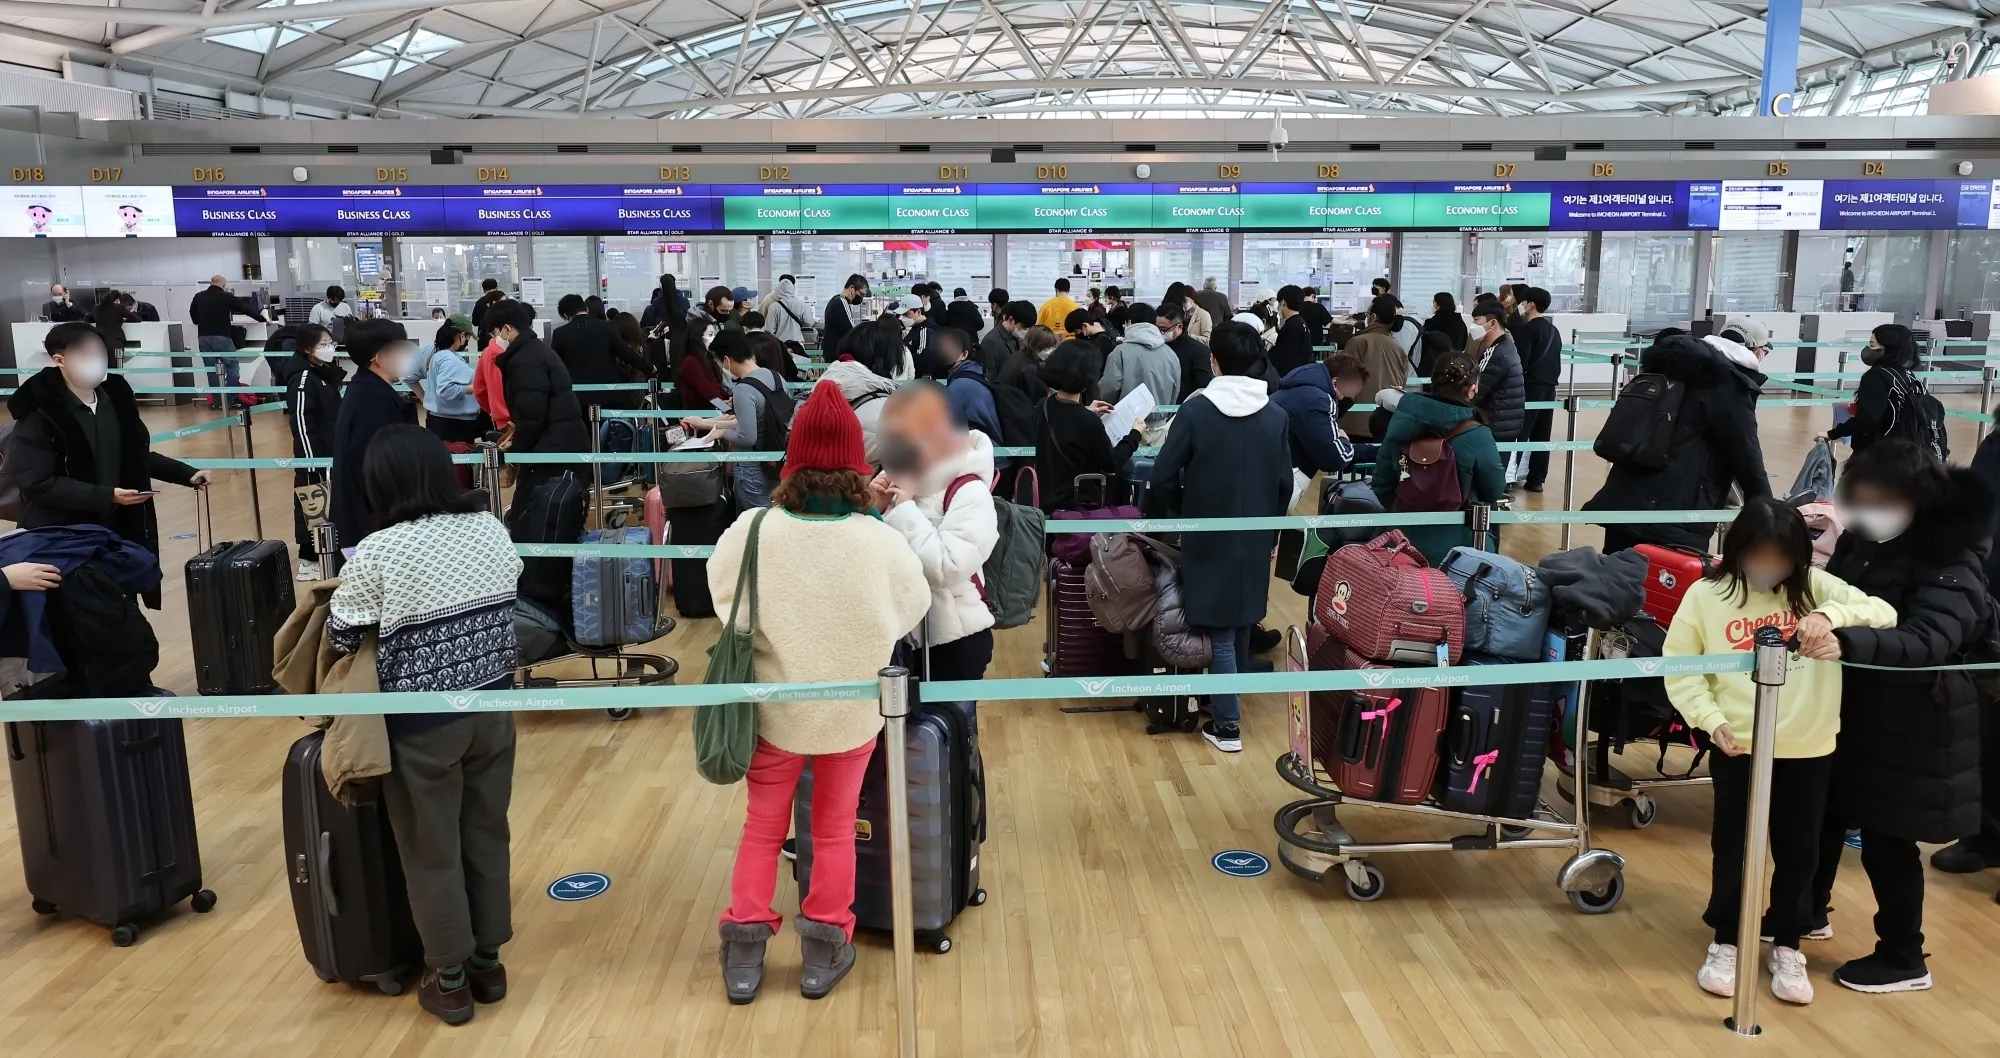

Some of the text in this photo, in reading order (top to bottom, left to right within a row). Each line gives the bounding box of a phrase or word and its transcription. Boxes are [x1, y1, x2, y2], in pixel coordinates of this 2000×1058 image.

[1772, 94, 1791, 118] C
[12, 167, 44, 182] D18
[91, 167, 122, 182] D17
[193, 167, 225, 181] D16
[376, 167, 408, 181] D15
[478, 167, 509, 181] D14
[660, 166, 690, 180] D13
[760, 166, 790, 180] D12
[940, 166, 968, 179] D11
[1038, 166, 1068, 179] D10
[1220, 164, 1241, 178] D9
[1319, 164, 1340, 178] D8
[1494, 164, 1516, 177] D7
[1593, 164, 1614, 177] D6
[1768, 162, 1788, 176] D5
[1864, 162, 1885, 176] D4
[1563, 194, 1674, 204] 여기는 제1여객터미널 입니다.
[1835, 193, 1944, 203] 여기는 제1여객터미널 입니다.
[202, 210, 276, 219] BUSINESS CLASS
[337, 210, 410, 219] BUSINESS CLASS
[478, 209, 551, 219] BUSINESS CLASS
[618, 208, 691, 218] BUSINESS CLASS
[757, 208, 831, 217] ECONOMY CLASS
[896, 208, 969, 217] ECONOMY CLASS
[1034, 207, 1107, 217] ECONOMY CLASS
[1172, 206, 1244, 216] ECONOMY CLASS
[1309, 206, 1382, 215] ECONOMY CLASS
[1446, 205, 1518, 215] ECONOMY CLASS
[1176, 523, 1198, 531] Airport
[1665, 661, 1740, 672] Incheon Airport
[1392, 673, 1469, 686] Incheon Airport
[778, 689, 860, 699] Incheon Airport
[1112, 682, 1191, 694] Incheon Airport
[479, 697, 564, 709] Incheon Airport
[169, 704, 258, 716] Incheon Airport
